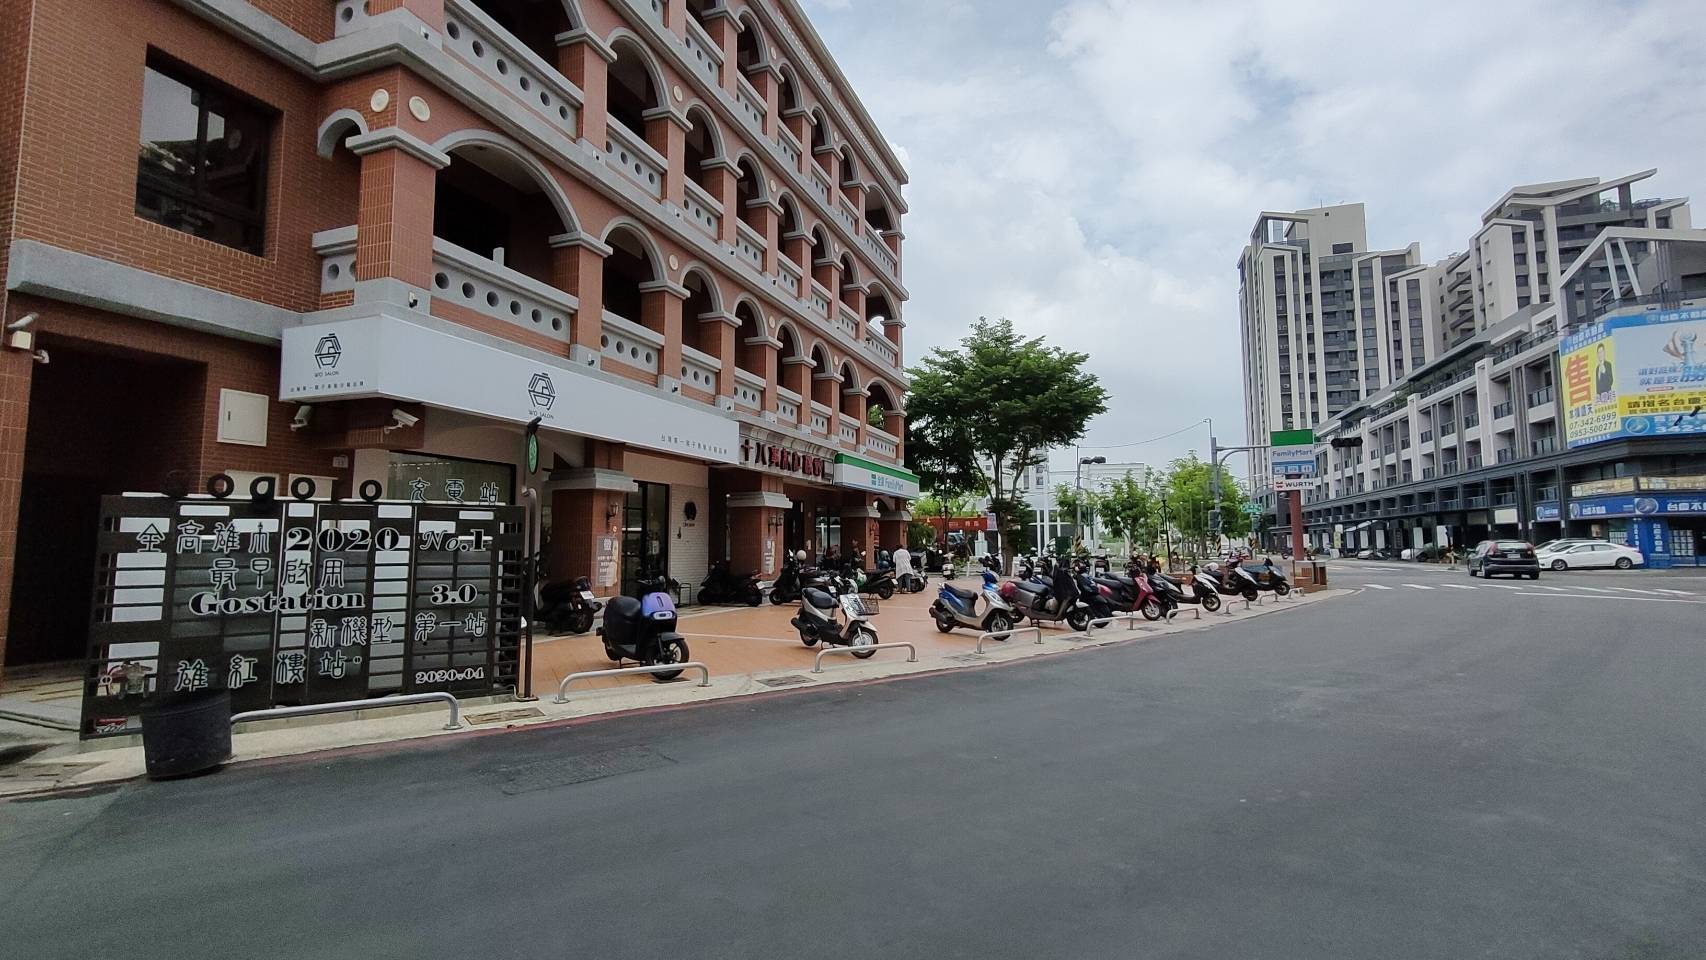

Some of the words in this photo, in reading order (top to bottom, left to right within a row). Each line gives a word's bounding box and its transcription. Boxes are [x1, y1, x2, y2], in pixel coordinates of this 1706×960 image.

[1565, 354, 1592, 406] 售
[1569, 411, 1617, 430] 07-342-6999
[1272, 449, 1312, 458] FamilyMart
[408, 476, 500, 505] 充電站
[136, 519, 271, 555] 全高雄市
[284, 527, 400, 552] 2020
[419, 528, 487, 552] No.1
[189, 588, 366, 615] Gostation
[430, 583, 478, 605] 3.0
[309, 616, 393, 649] 新機型
[414, 612, 486, 642] 第一站
[415, 667, 485, 684] 2020.04
